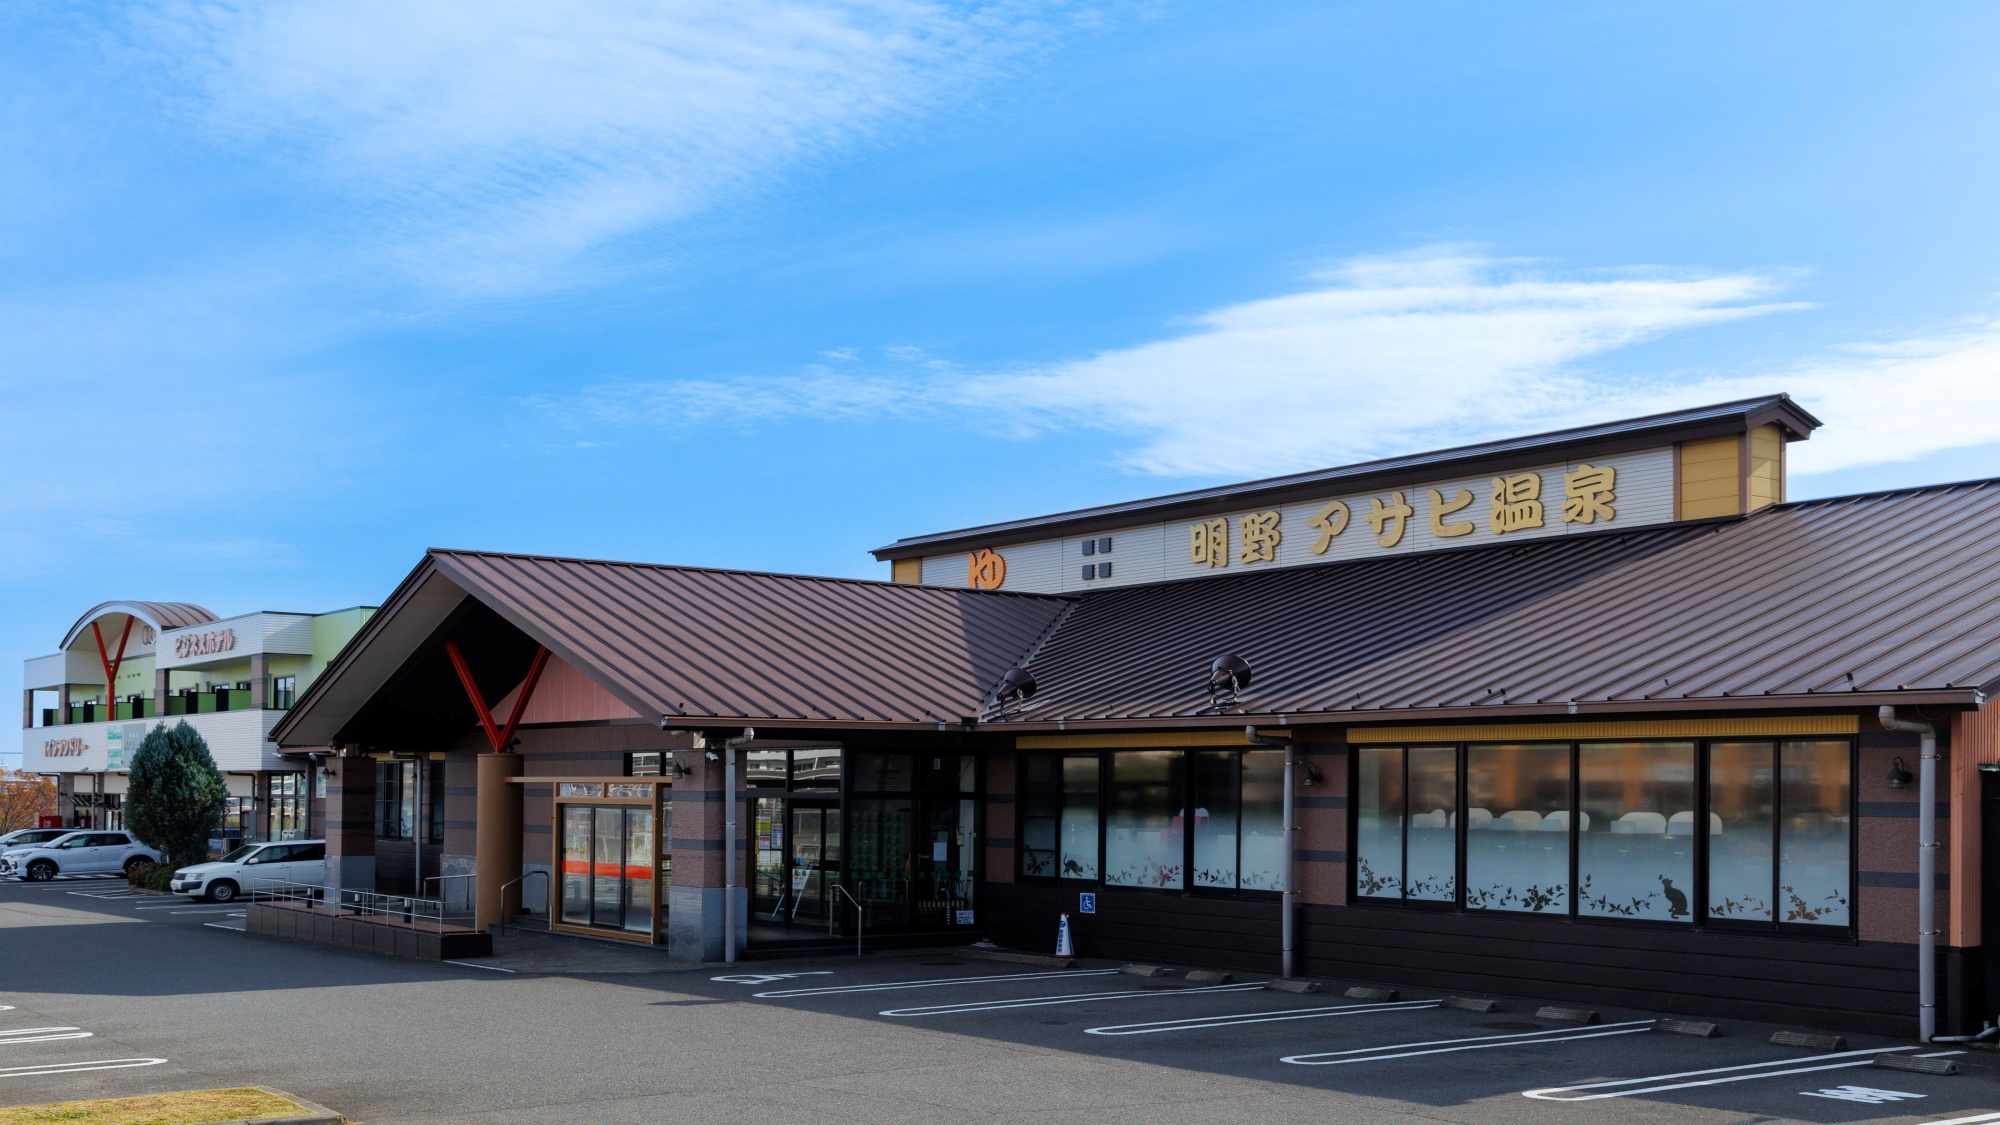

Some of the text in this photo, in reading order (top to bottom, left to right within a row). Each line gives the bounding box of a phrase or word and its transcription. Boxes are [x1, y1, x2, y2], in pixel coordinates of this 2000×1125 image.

[968, 547, 1006, 590] ゆ
[174, 628, 235, 658] ビジネスホテル
[42, 737, 88, 757] コインランドリー
